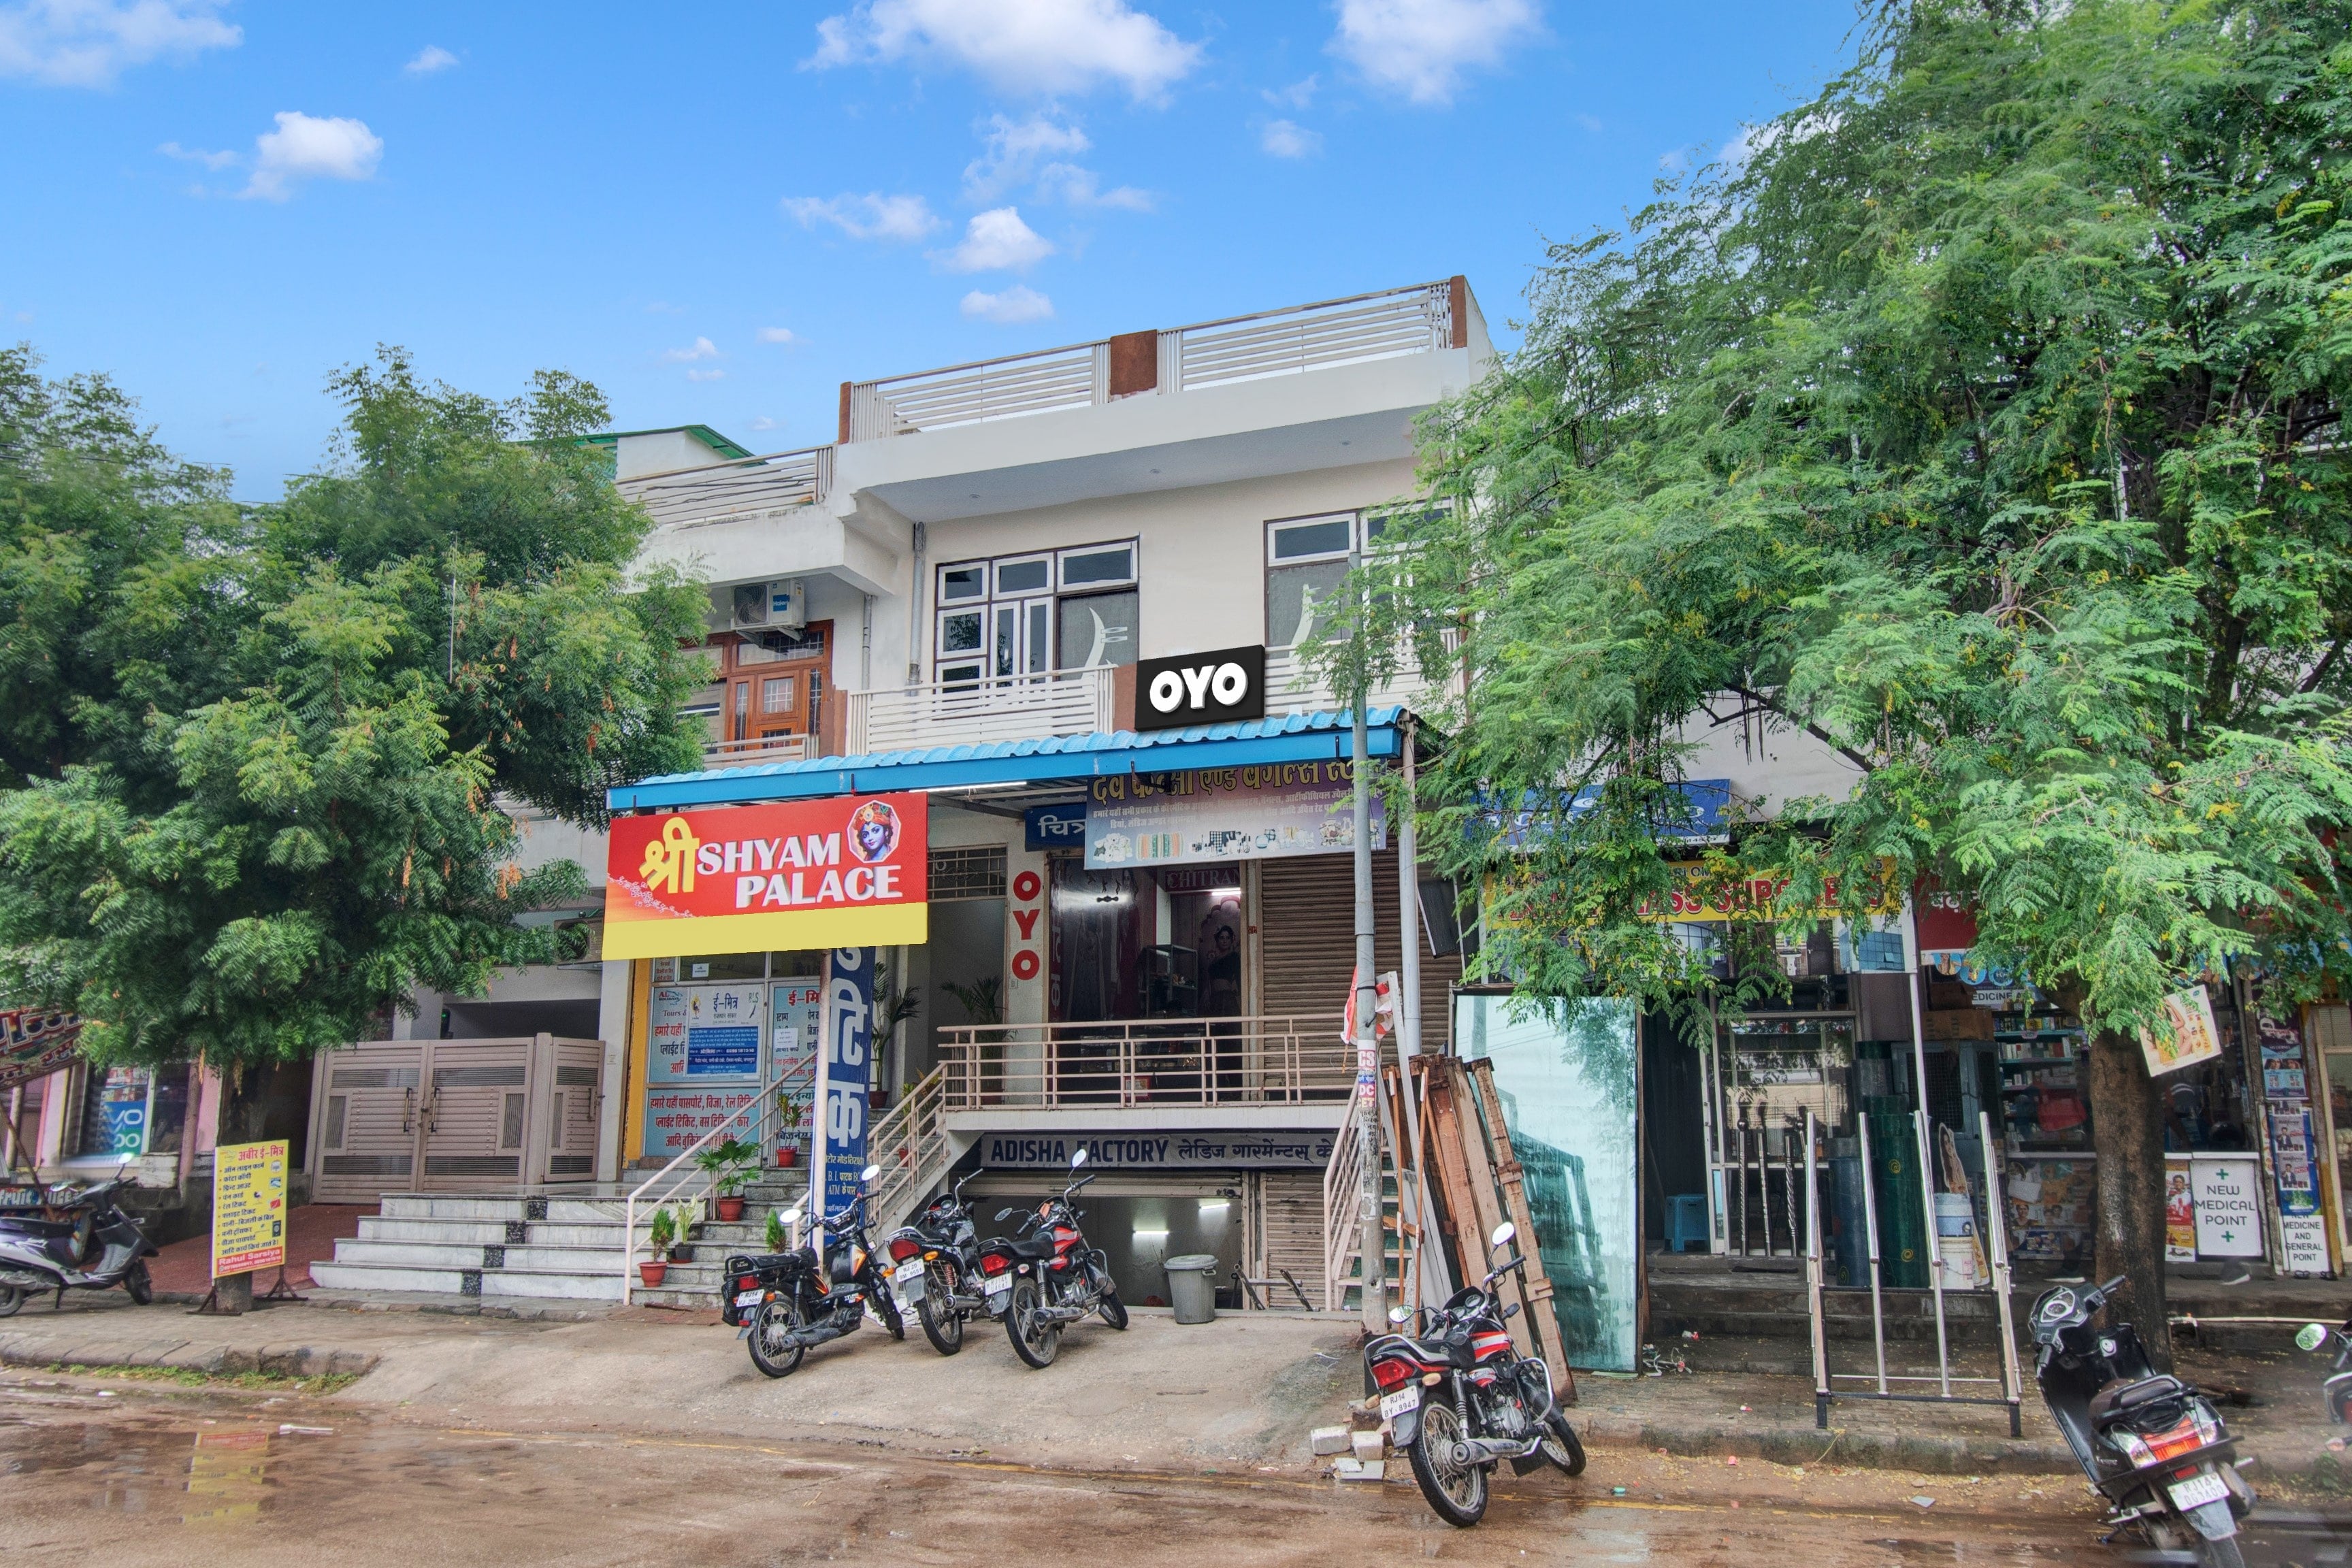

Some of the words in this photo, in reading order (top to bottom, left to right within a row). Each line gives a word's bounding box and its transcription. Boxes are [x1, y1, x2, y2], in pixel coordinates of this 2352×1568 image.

[1149, 662, 1248, 713] OYO
[639, 817, 700, 894] श्री
[698, 832, 841, 876] SHYAM
[735, 864, 903, 909] PALACE
[1012, 870, 1041, 980] OYO
[1972, 992, 2013, 1001] EDICINE
[654, 1023, 670, 1036] हमारे
[670, 1022, 683, 1036] यहाँ
[650, 1094, 665, 1109] हमारे
[666, 1094, 678, 1109] यहाँ
[725, 1094, 735, 1109] रेल
[655, 1114, 674, 1129] प्लाईट
[700, 1117, 710, 1128] बस
[737, 1116, 749, 1128] कार
[666, 1132, 681, 1147] आदि
[991, 1140, 1066, 1162] ADISHA
[1178, 1138, 1226, 1160] लेडिज
[828, 1184, 840, 1195] ATM
[2206, 1185, 2240, 1196] NEW
[2195, 1200, 2256, 1211] MEDICAL
[2205, 1215, 2247, 1226] POINT
[2285, 1243, 2323, 1251] GENERAL
[218, 1254, 245, 1265] Rahul
[247, 1249, 280, 1260] Sarsiya
[1390, 1392, 1405, 1404] RJ14
[1399, 1399, 1416, 1411] 8947
